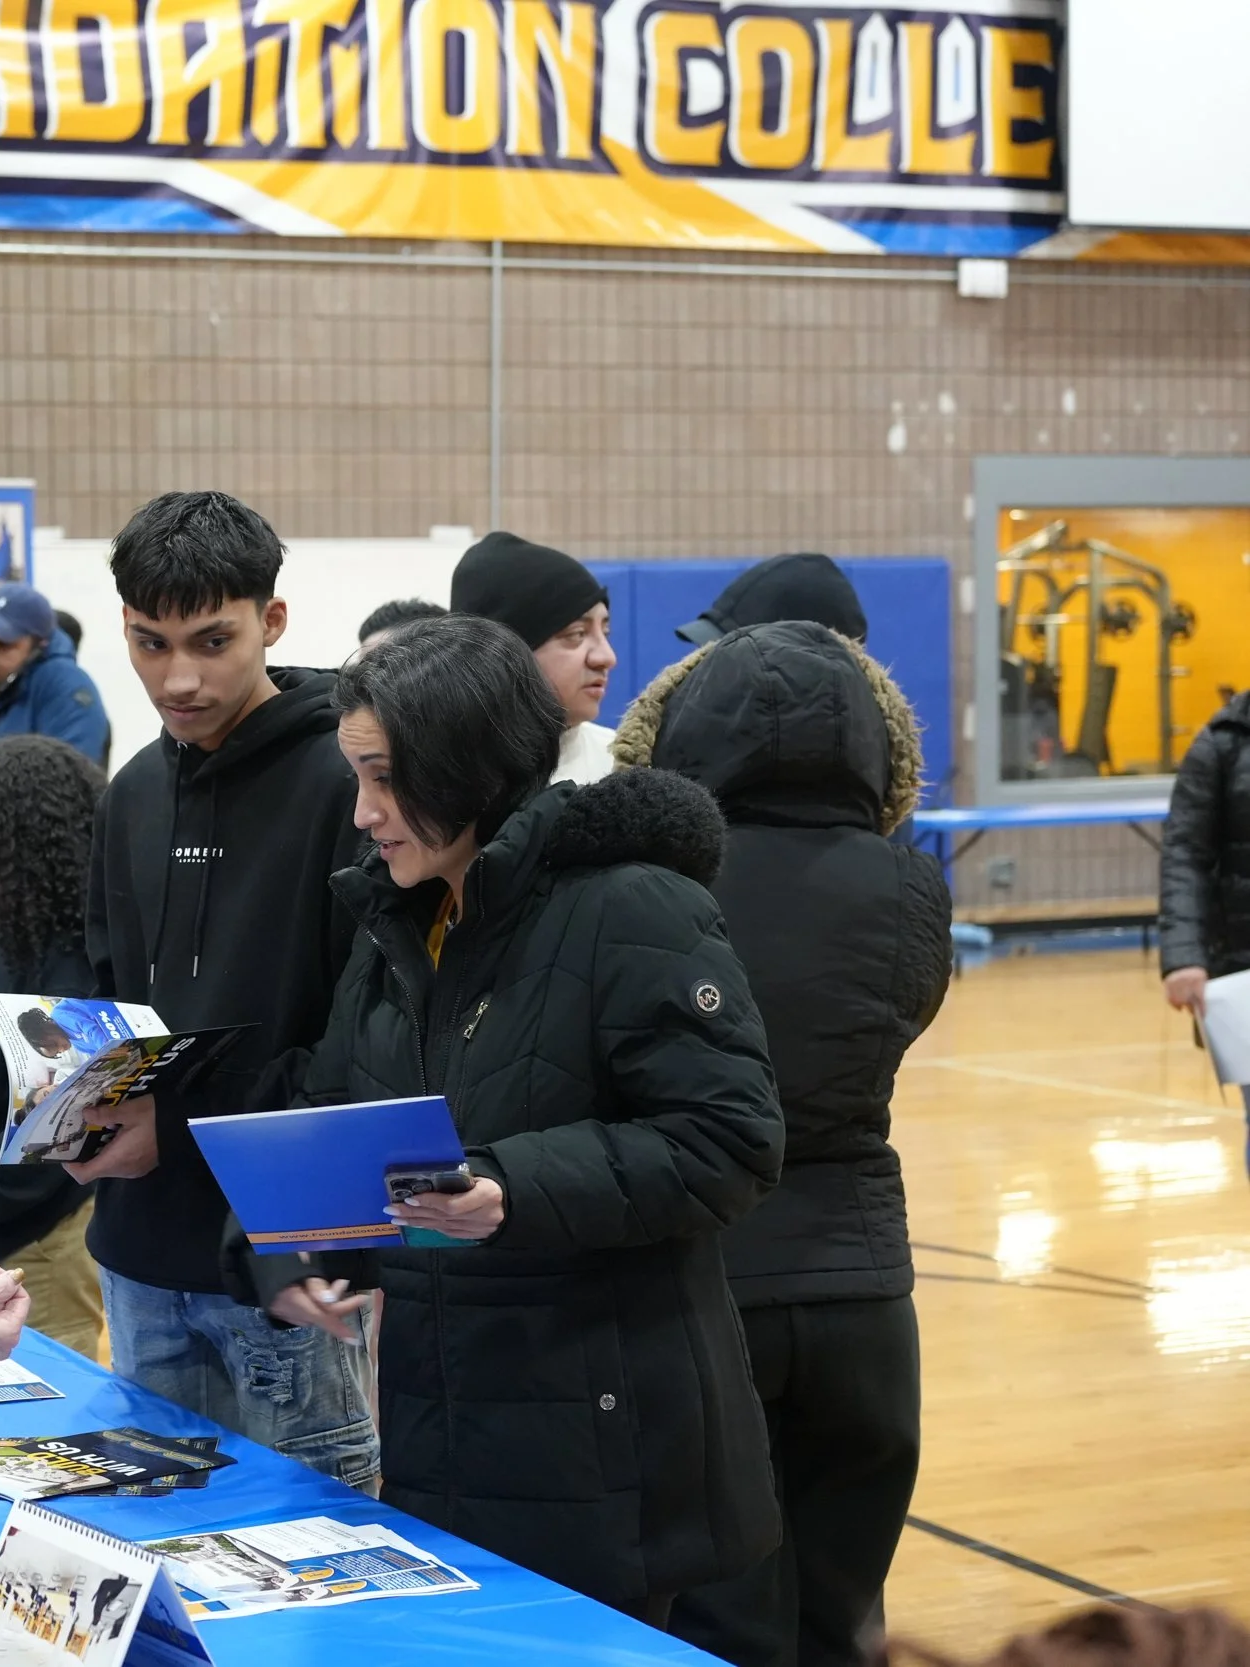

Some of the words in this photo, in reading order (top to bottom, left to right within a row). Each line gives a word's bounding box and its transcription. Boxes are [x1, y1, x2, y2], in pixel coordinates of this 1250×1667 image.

[98, 1010, 121, 1039] 00%
[152, 1037, 196, 1067] US
[103, 1055, 159, 1106] UILD
[38, 1441, 81, 1456] US
[27, 1452, 107, 1476] BUILD
[71, 1453, 147, 1477] WITH
